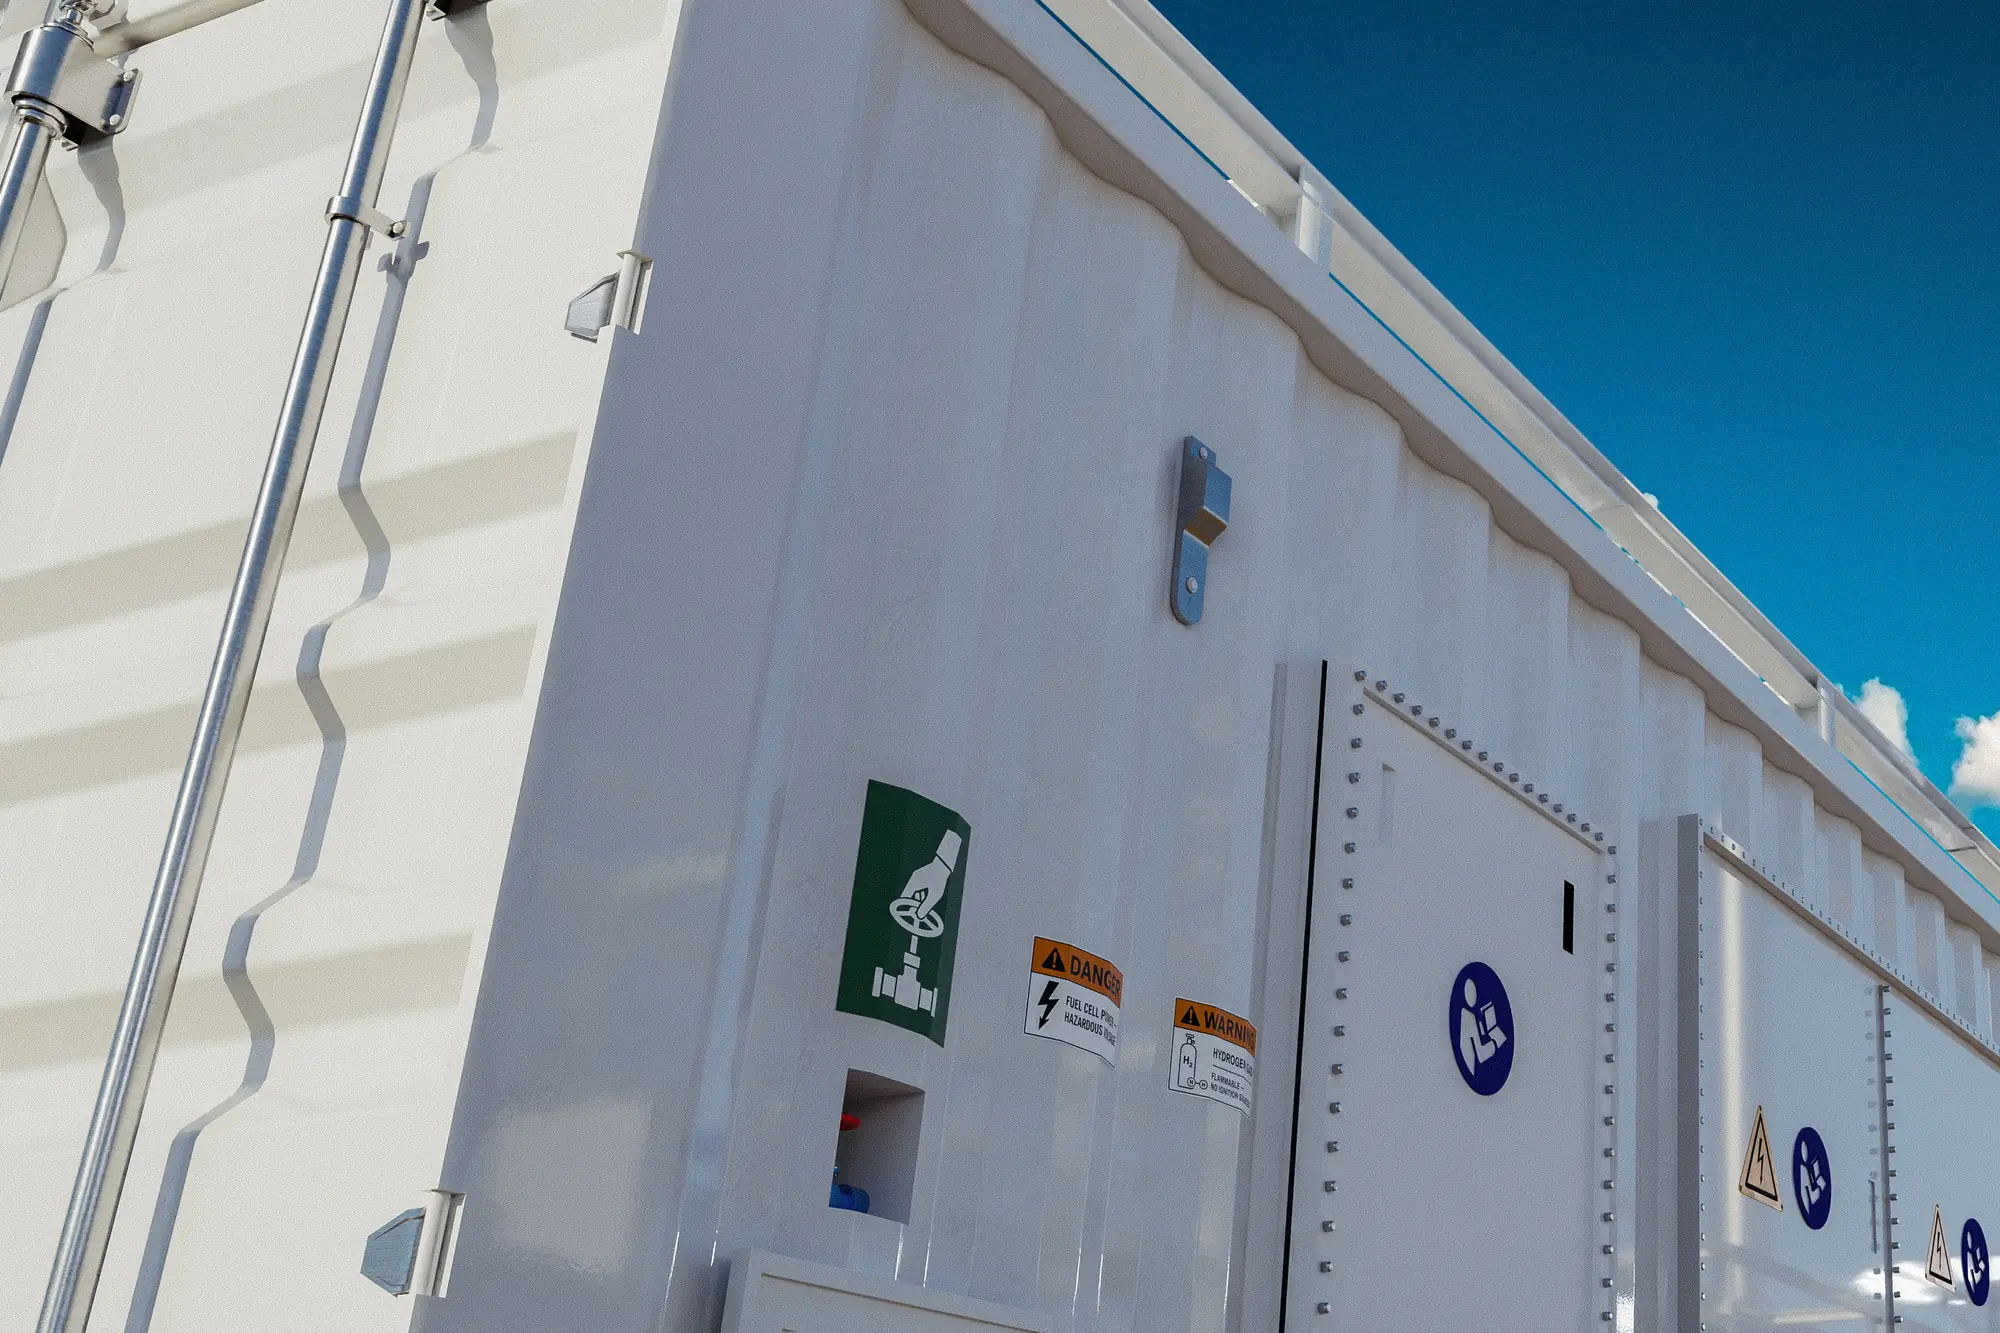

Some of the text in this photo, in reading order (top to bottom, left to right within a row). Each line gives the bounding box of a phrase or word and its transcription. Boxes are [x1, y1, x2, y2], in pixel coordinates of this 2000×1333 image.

[1069, 954, 1120, 999] DANGER
[1065, 995, 1082, 1012] FUEL
[1083, 1002, 1099, 1019] CELL
[1064, 1011, 1103, 1036] HAZARDOUS
